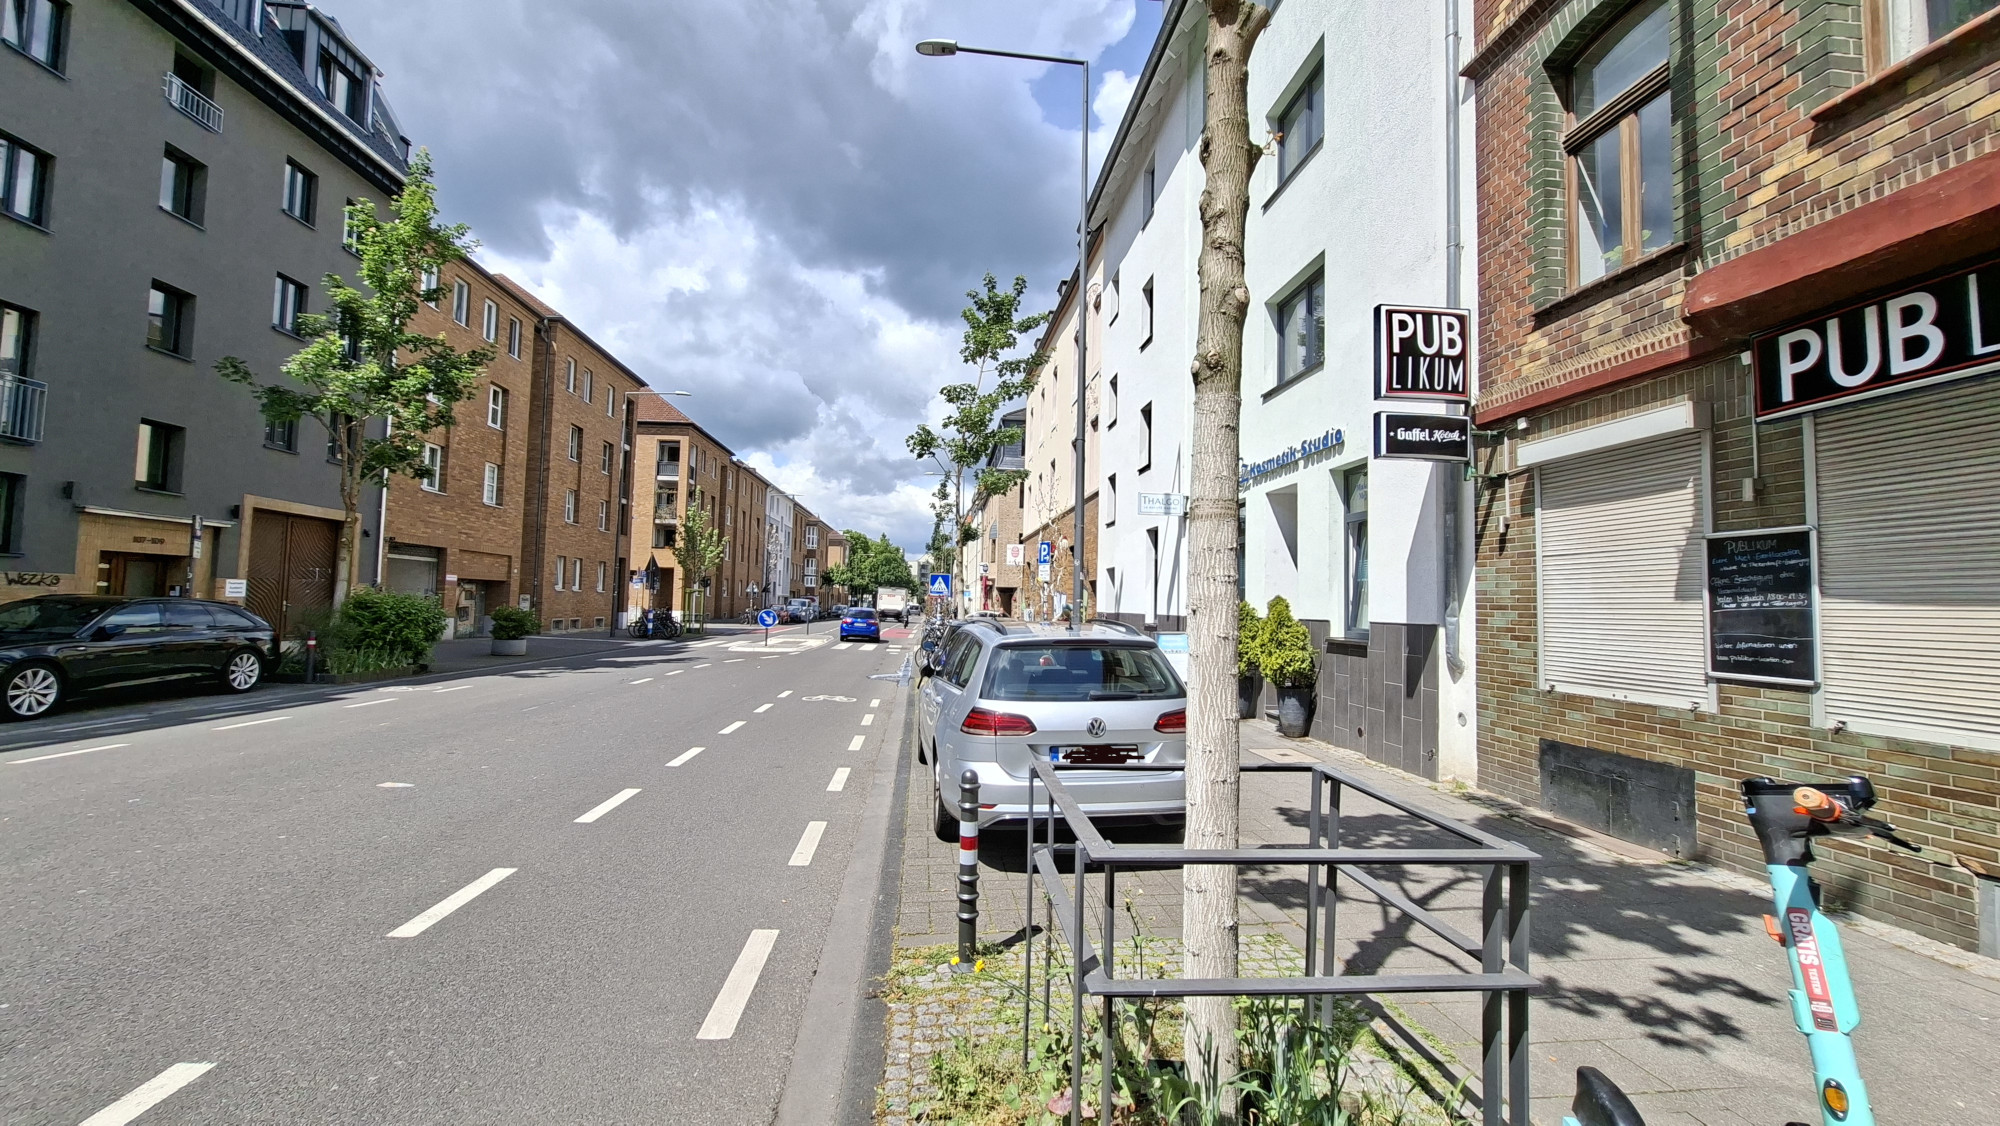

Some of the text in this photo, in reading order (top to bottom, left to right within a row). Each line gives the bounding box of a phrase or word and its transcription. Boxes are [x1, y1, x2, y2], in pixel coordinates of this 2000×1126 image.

[1391, 313, 1463, 356] PUB
[1778, 291, 1946, 403] PUB
[1392, 355, 1464, 392] LIKUM
[1249, 428, 1343, 478] Kosmetik-Studio
[1397, 427, 1461, 443] Gaffel Kölsch
[1141, 495, 1180, 506] THALGO
[1041, 544, 1049, 562] P
[1723, 539, 1777, 554] PUBLIKUM
[1788, 912, 1820, 967] GRATIS
